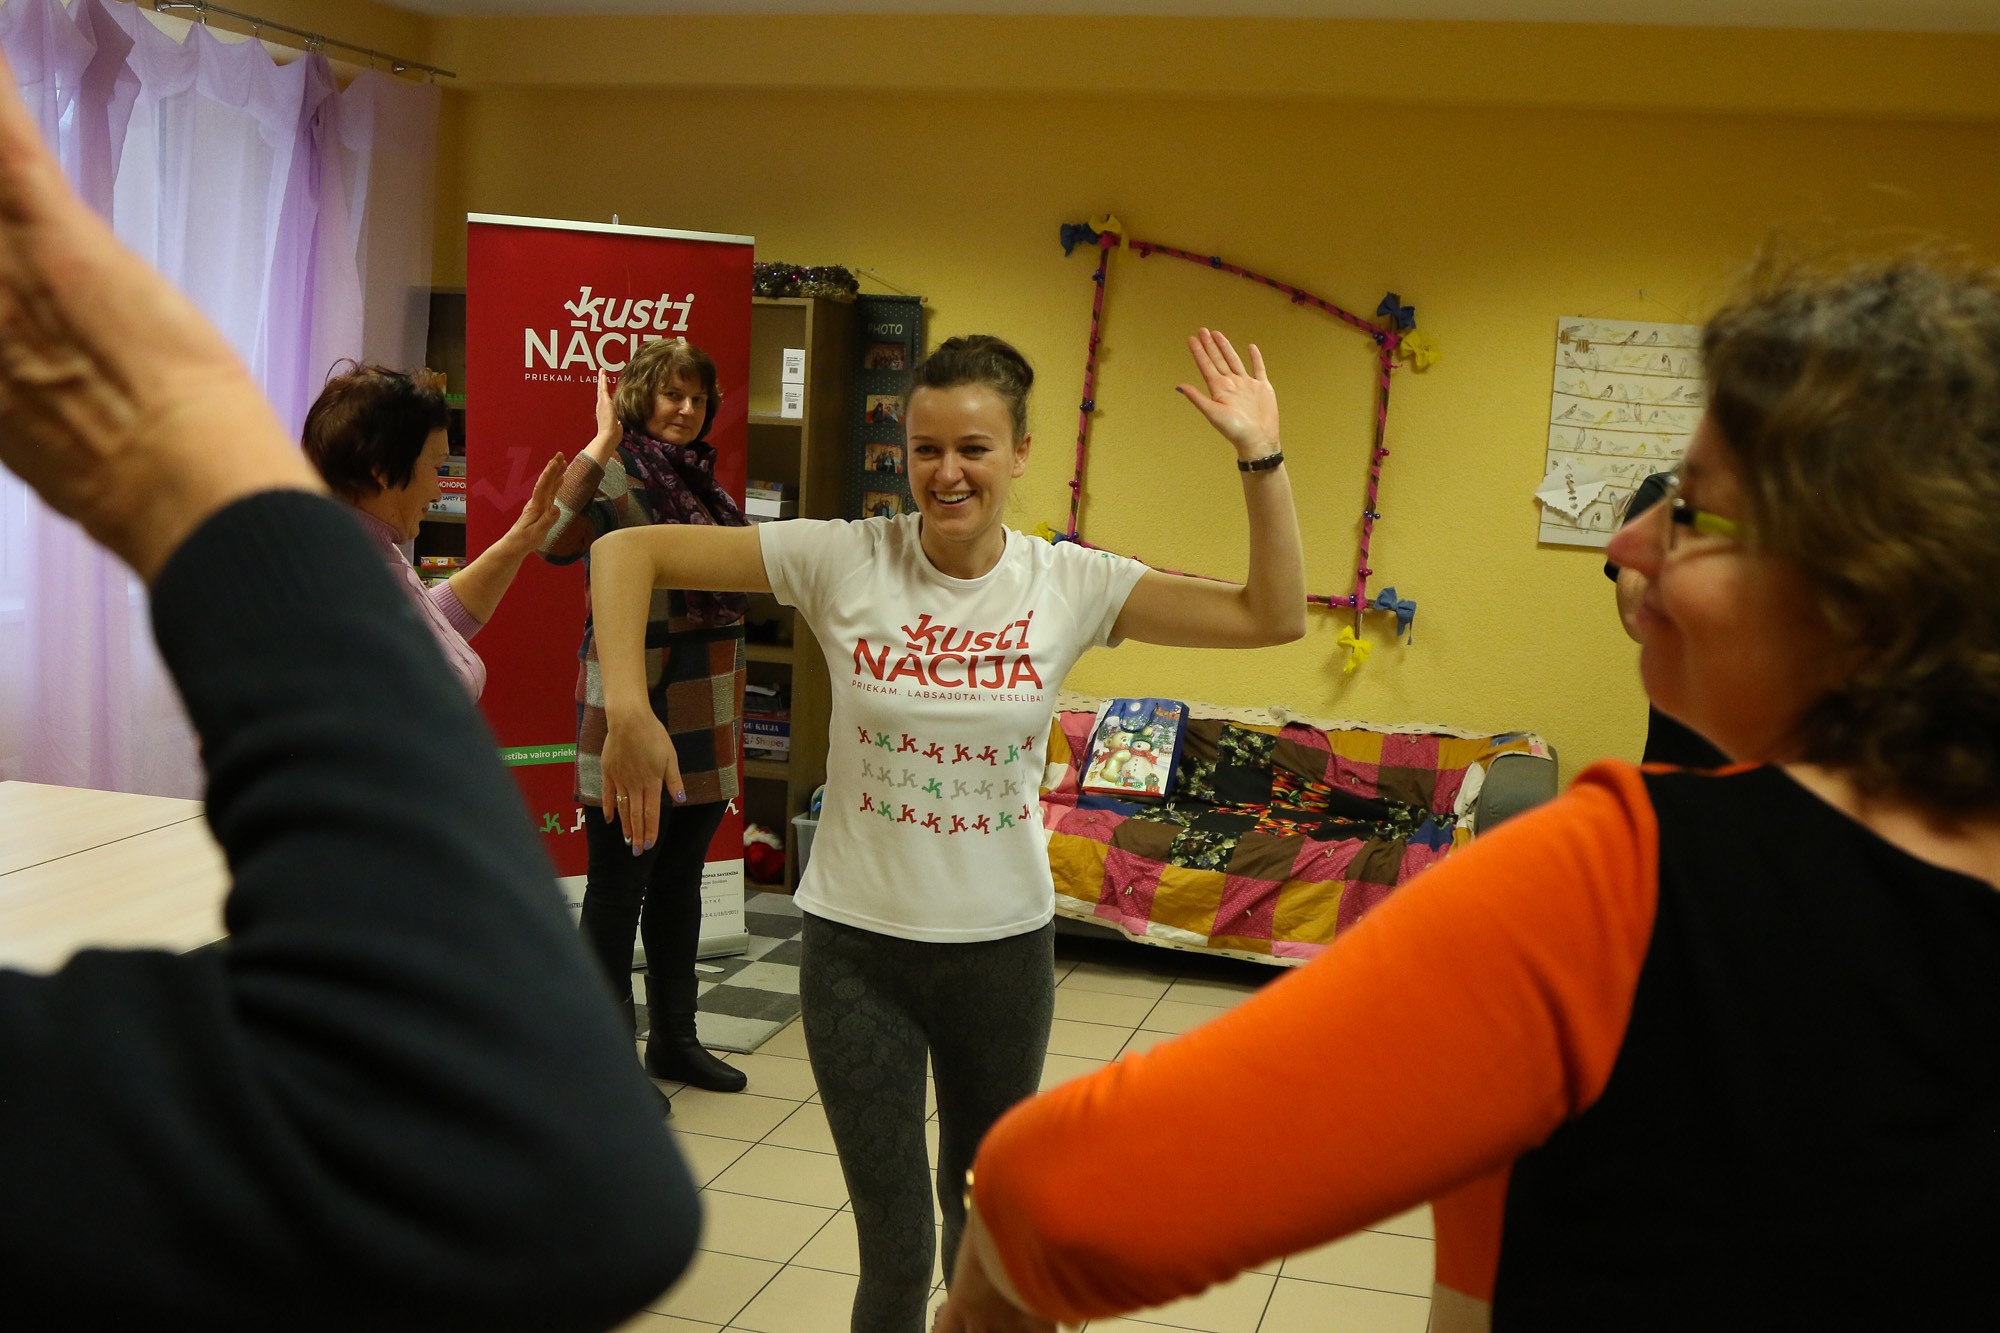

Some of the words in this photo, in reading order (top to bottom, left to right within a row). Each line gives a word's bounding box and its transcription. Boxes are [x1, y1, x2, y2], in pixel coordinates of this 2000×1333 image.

[563, 286, 695, 332] kusti
[868, 323, 903, 335] PHOTO
[524, 320, 688, 372] NĀCI
[525, 373, 575, 383] PRIEKAM.
[438, 481, 466, 489] MONOPO
[901, 610, 1034, 656] kusti
[853, 637, 1043, 690] NĀCIJA
[851, 680, 901, 696] PRIEKAM.
[529, 750, 551, 759] vairo
